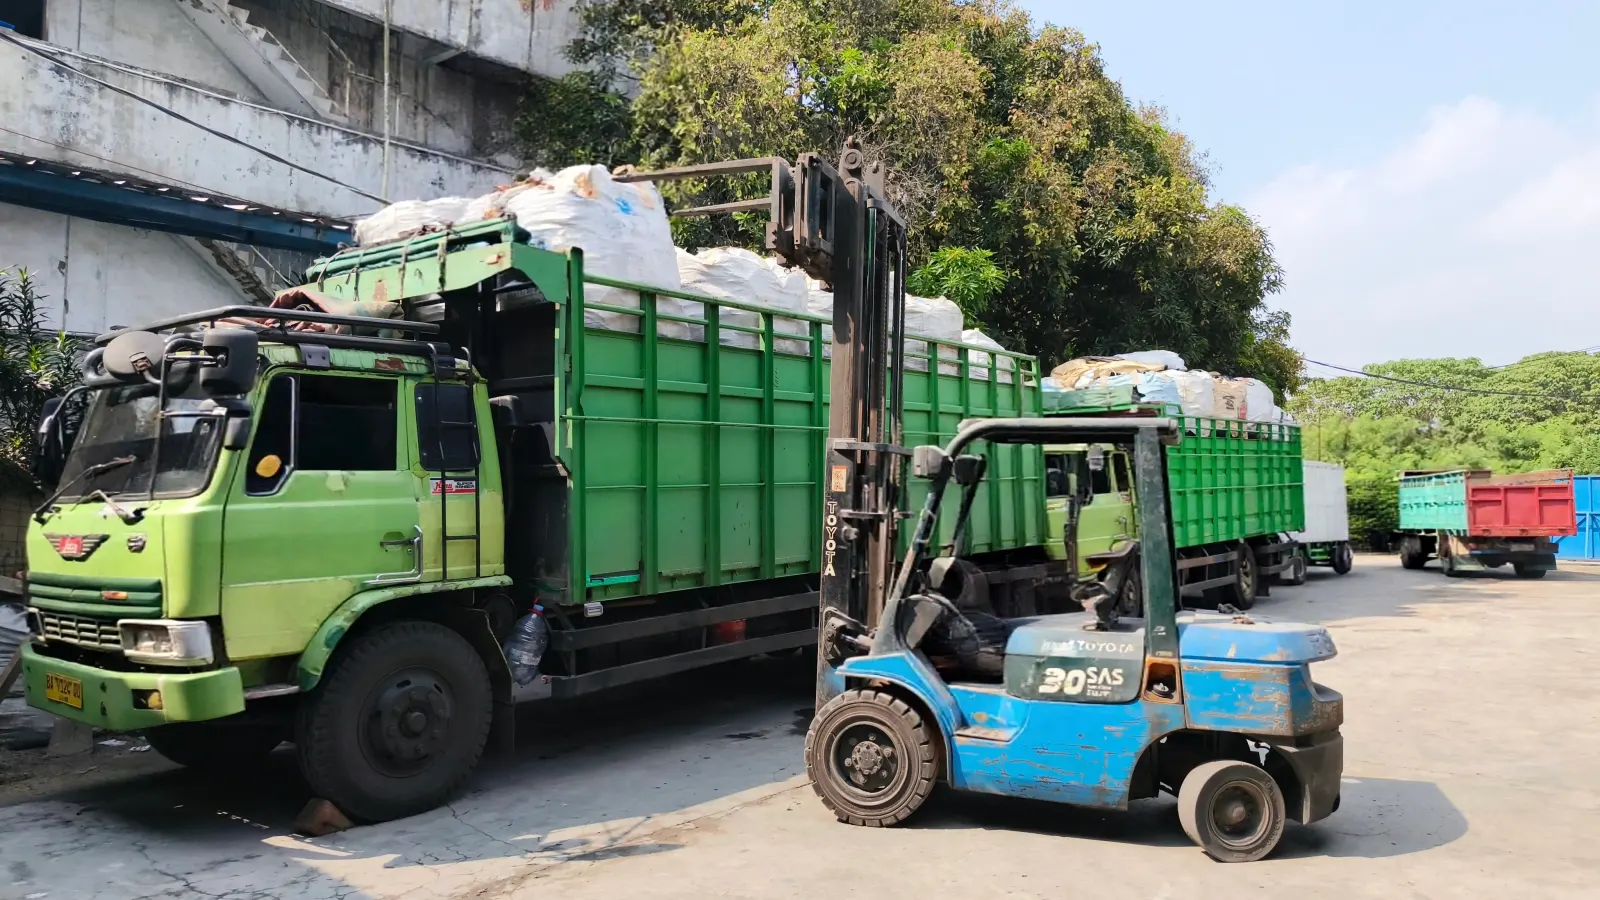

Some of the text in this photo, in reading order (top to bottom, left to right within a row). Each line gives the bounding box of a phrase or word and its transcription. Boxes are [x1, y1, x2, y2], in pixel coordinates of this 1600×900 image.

[824, 501, 838, 577] TOYOTA
[1038, 667, 1086, 695] 30
[1086, 666, 1125, 685] SAS
